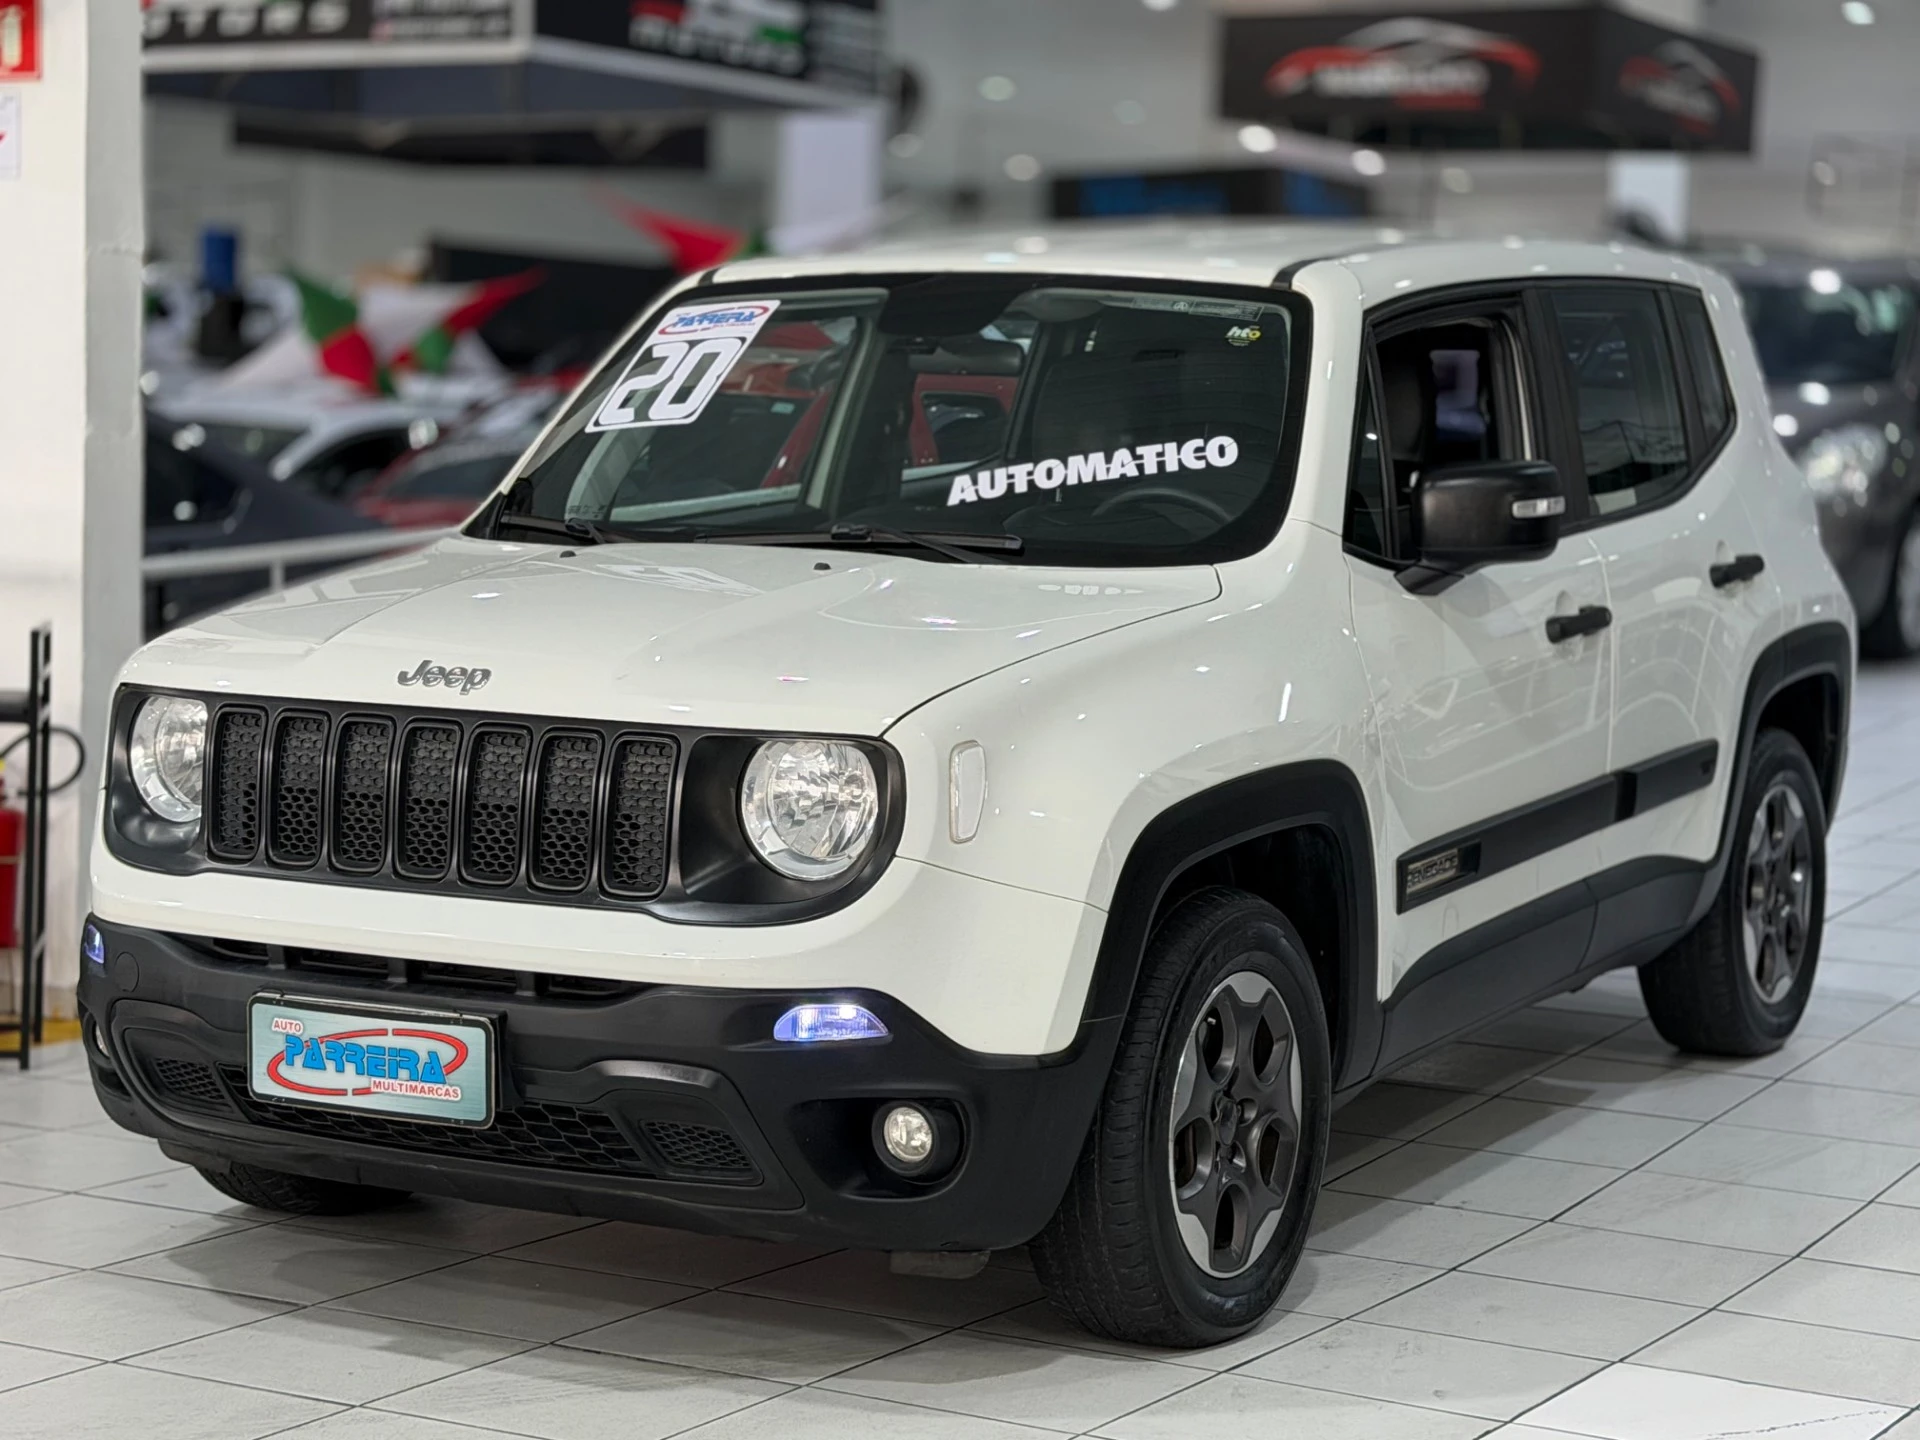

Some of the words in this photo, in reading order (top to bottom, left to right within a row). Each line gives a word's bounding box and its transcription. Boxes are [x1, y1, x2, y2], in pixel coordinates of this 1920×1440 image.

[599, 337, 742, 425] 20
[946, 435, 1239, 506] AUTOMATICO
[397, 659, 492, 696] Jeep
[273, 1018, 302, 1033] AUTO
[284, 1034, 448, 1085] PARREIRA
[372, 1079, 460, 1099] MULTIMARCAS
